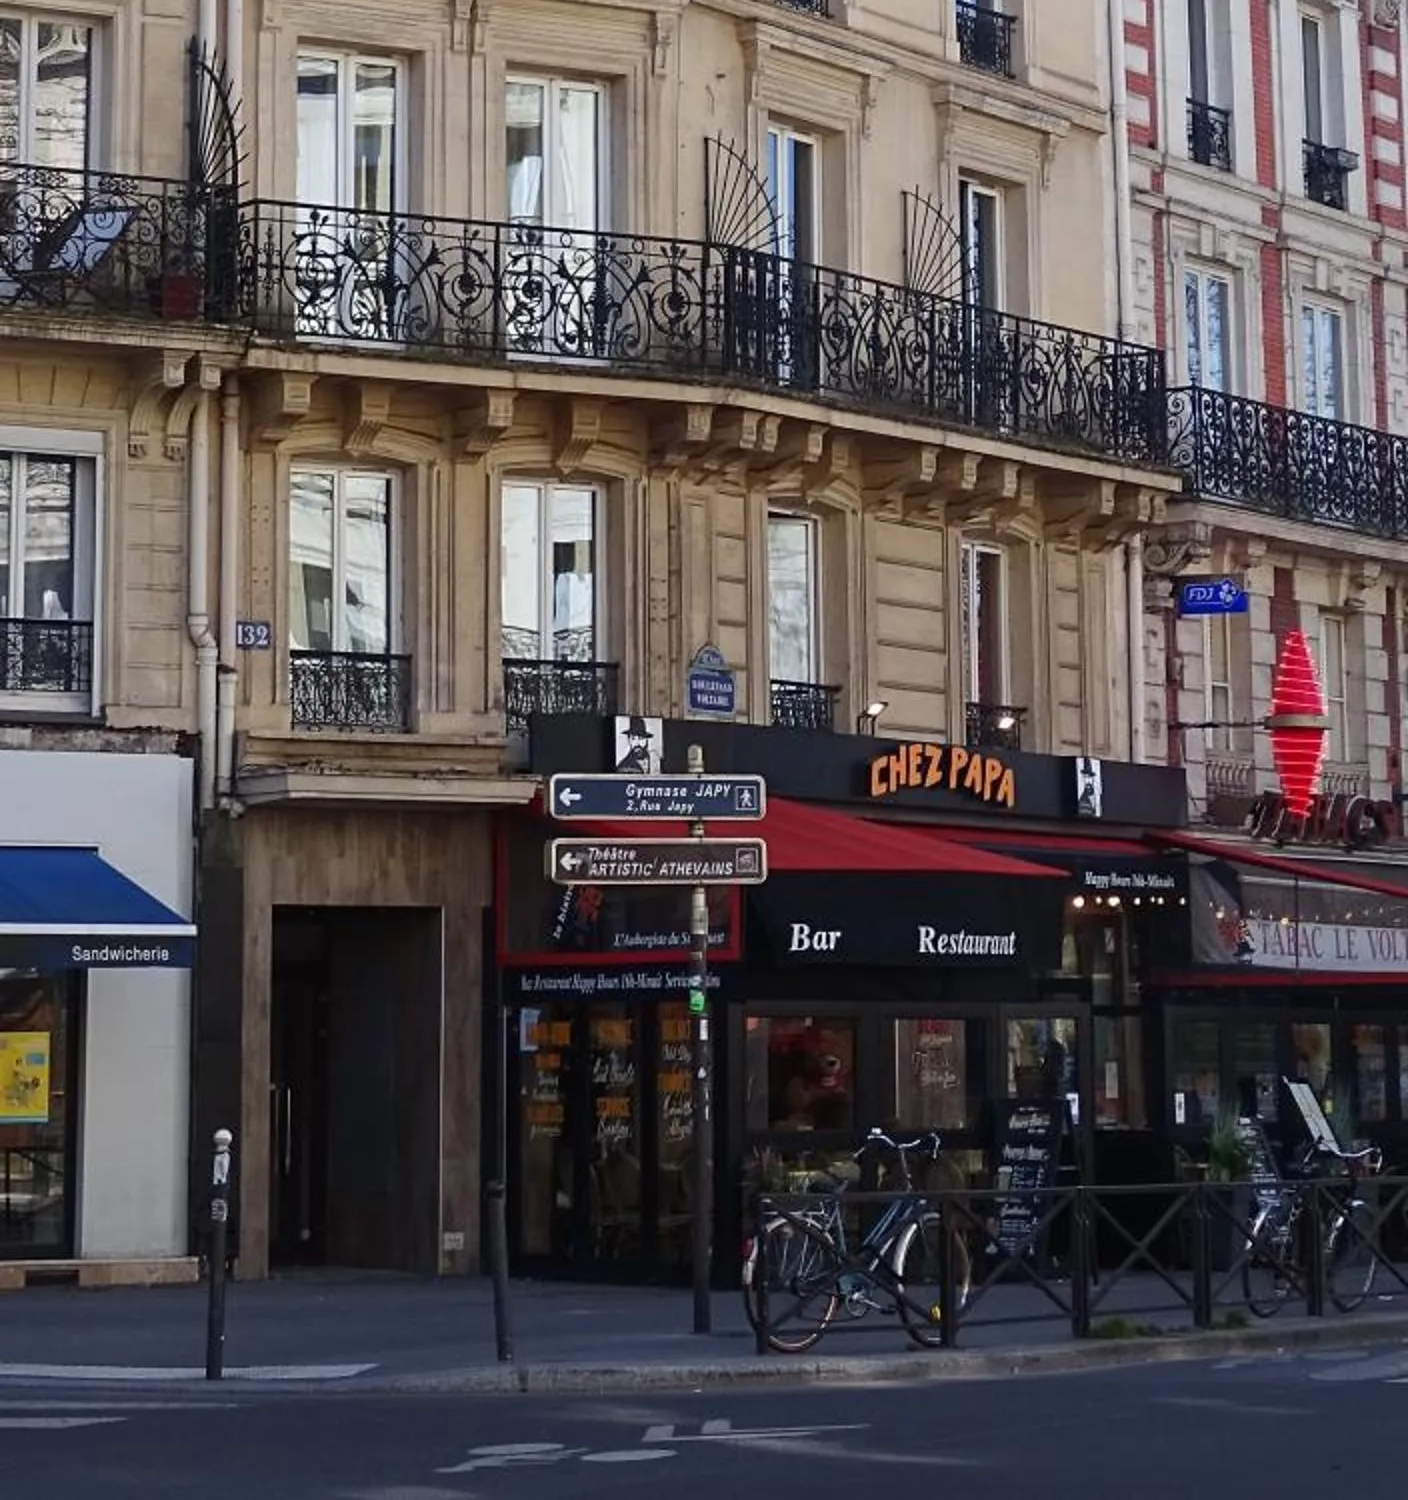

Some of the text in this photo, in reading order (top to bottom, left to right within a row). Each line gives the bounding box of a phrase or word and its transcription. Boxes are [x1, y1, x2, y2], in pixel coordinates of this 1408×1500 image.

[1188, 587, 1214, 601] FDJ
[237, 624, 268, 645] 132
[871, 743, 1016, 808] CHEZ PAPA
[625, 783, 731, 799] Gymnase JAPY
[667, 800, 695, 814] Japy
[588, 862, 734, 876] ARTISTIC ATHEVAINS
[789, 923, 1017, 955] Bar Restaurant
[1261, 923, 1325, 958] TABAC
[1334, 927, 1360, 960] LE
[72, 945, 169, 961] Sandwicherie
